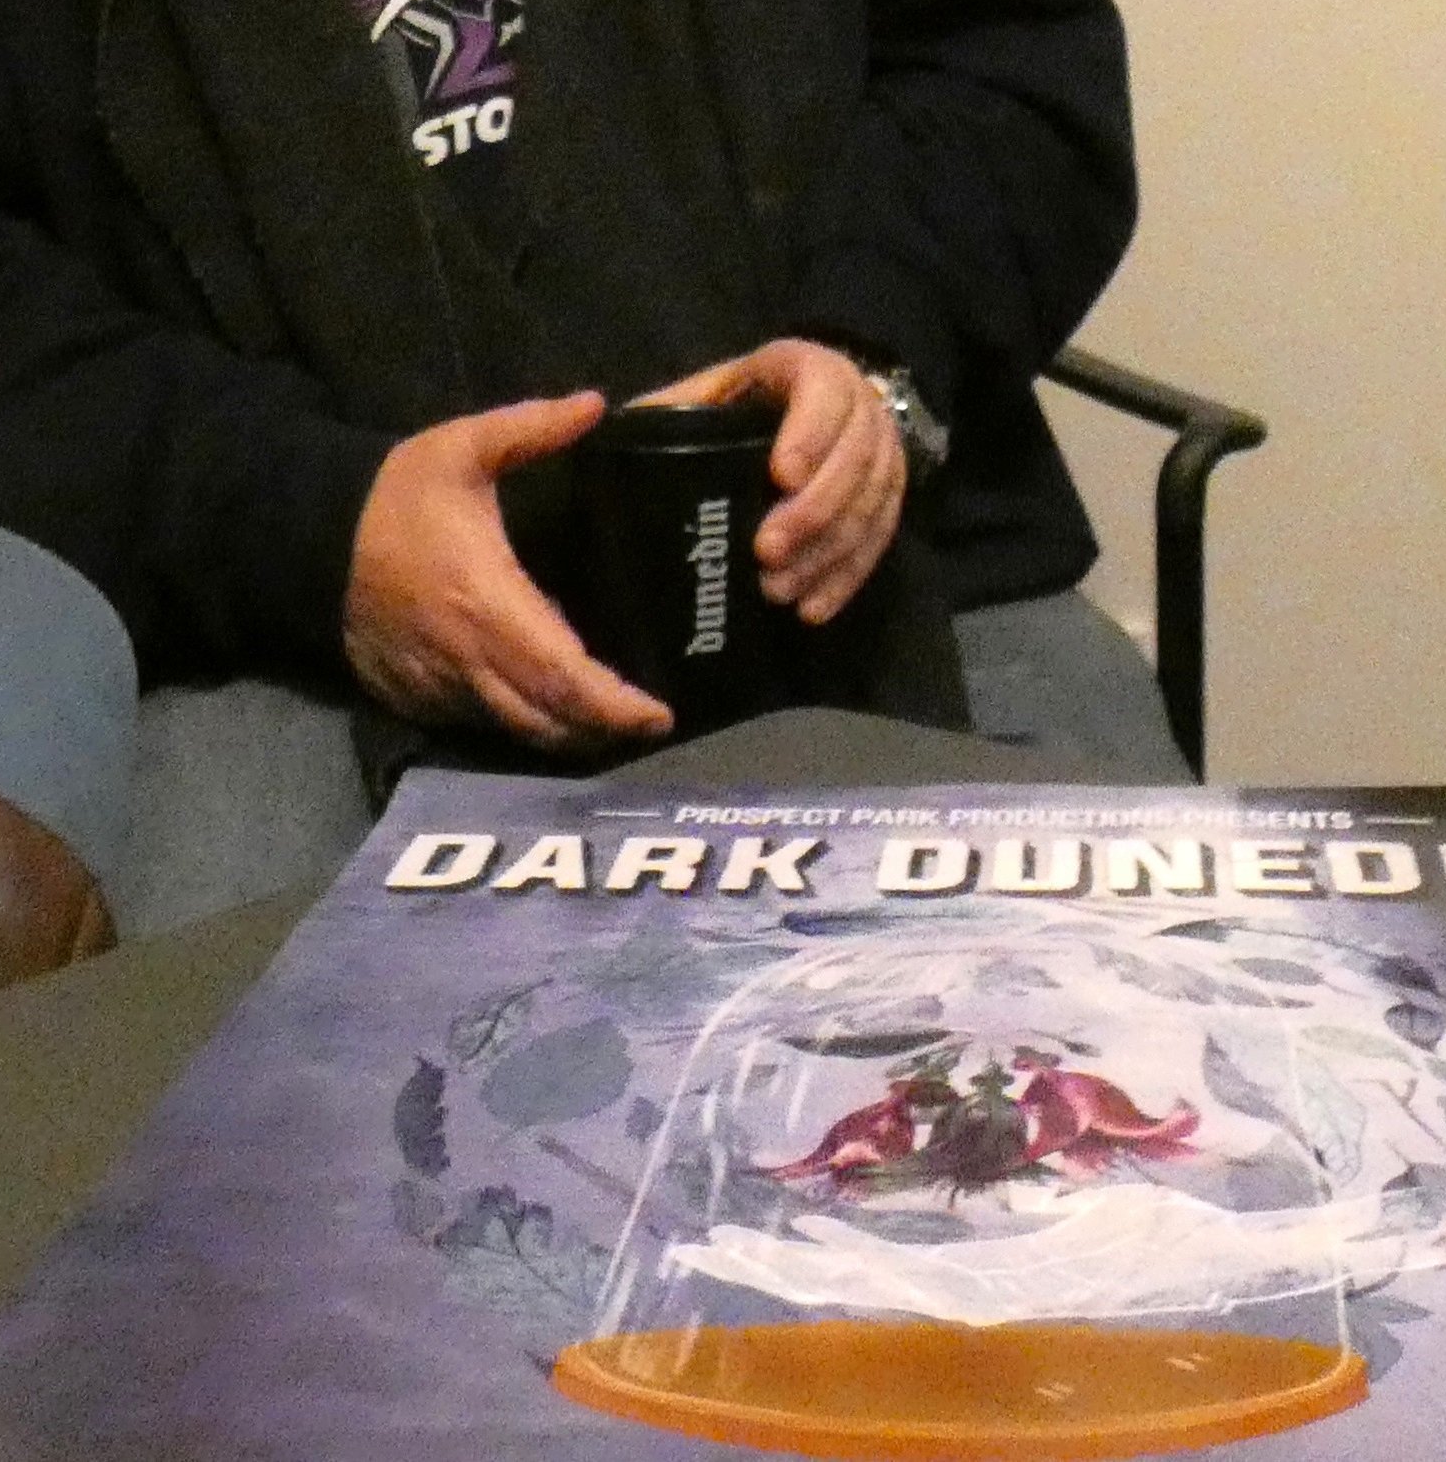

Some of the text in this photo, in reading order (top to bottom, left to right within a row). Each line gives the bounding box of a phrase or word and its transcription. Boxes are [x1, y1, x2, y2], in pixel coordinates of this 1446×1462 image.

[684, 498, 730, 656] dunedin
[674, 806, 1354, 830] PROSPECT PARK PRODUCTIONS PRESENTS
[385, 834, 823, 892] DARK
